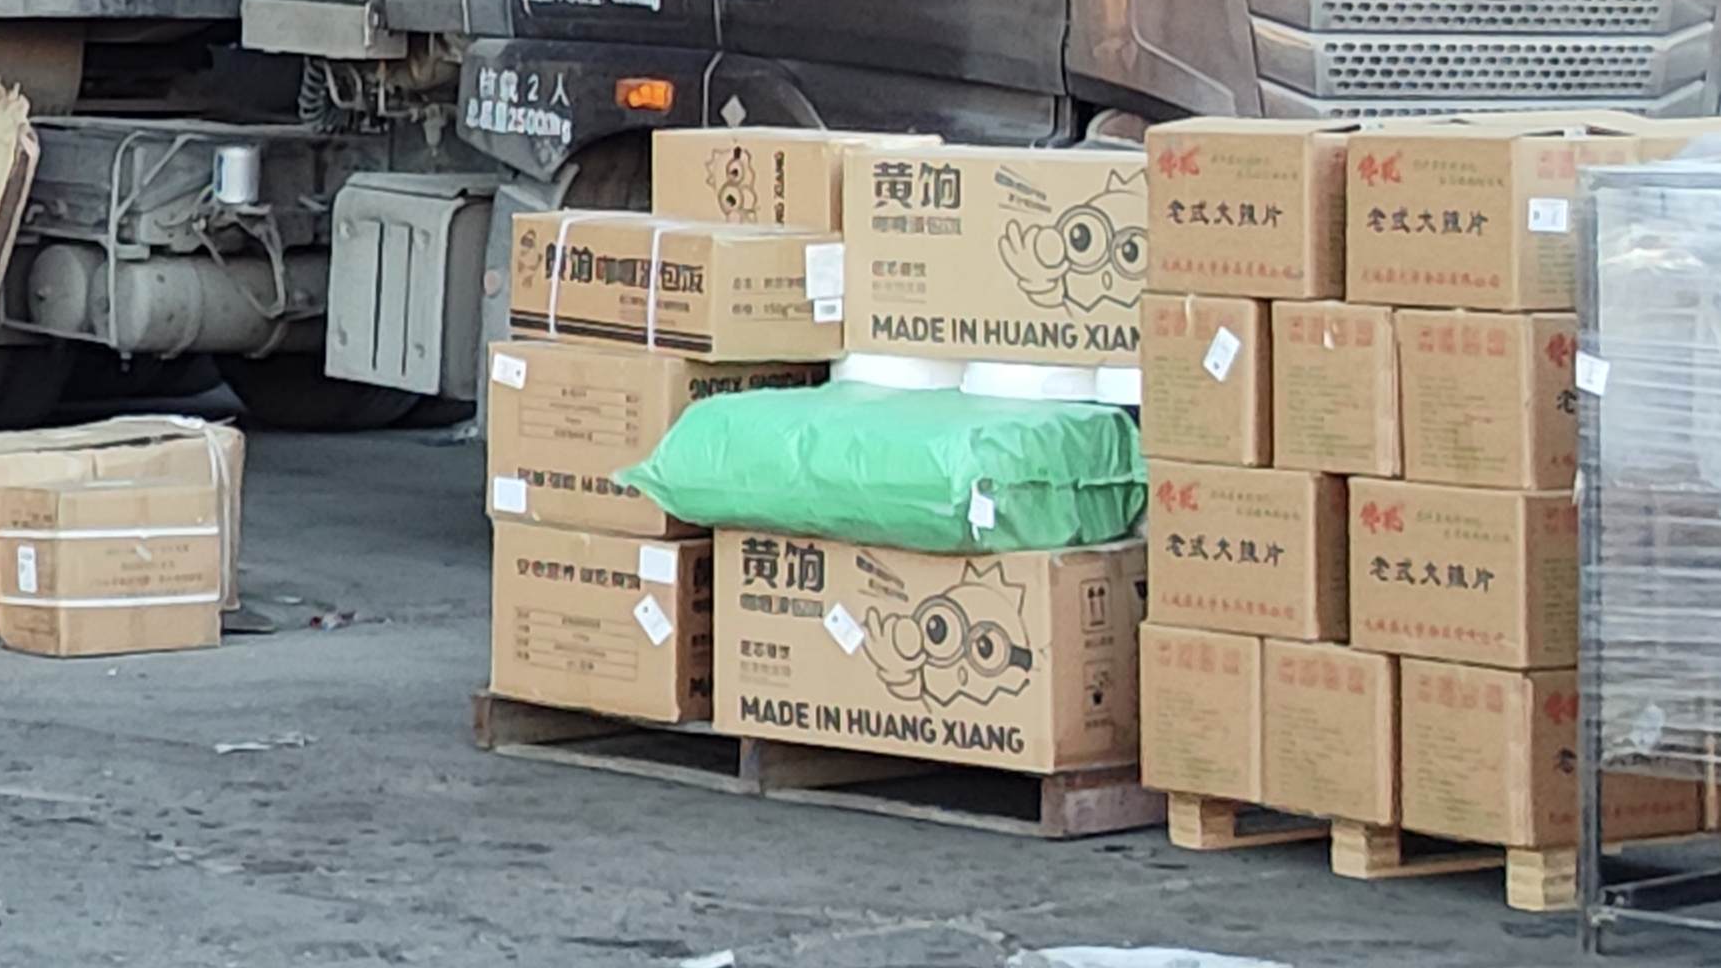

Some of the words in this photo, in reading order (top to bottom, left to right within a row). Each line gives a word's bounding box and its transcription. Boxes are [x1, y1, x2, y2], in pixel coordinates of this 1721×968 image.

[872, 314, 945, 343] MADE
[952, 318, 977, 345] IN
[984, 319, 1078, 350] HUANG
[740, 695, 809, 730] MADE
[816, 704, 841, 733] IN
[847, 708, 937, 745] HUANG
[942, 718, 1024, 754] XIANG
